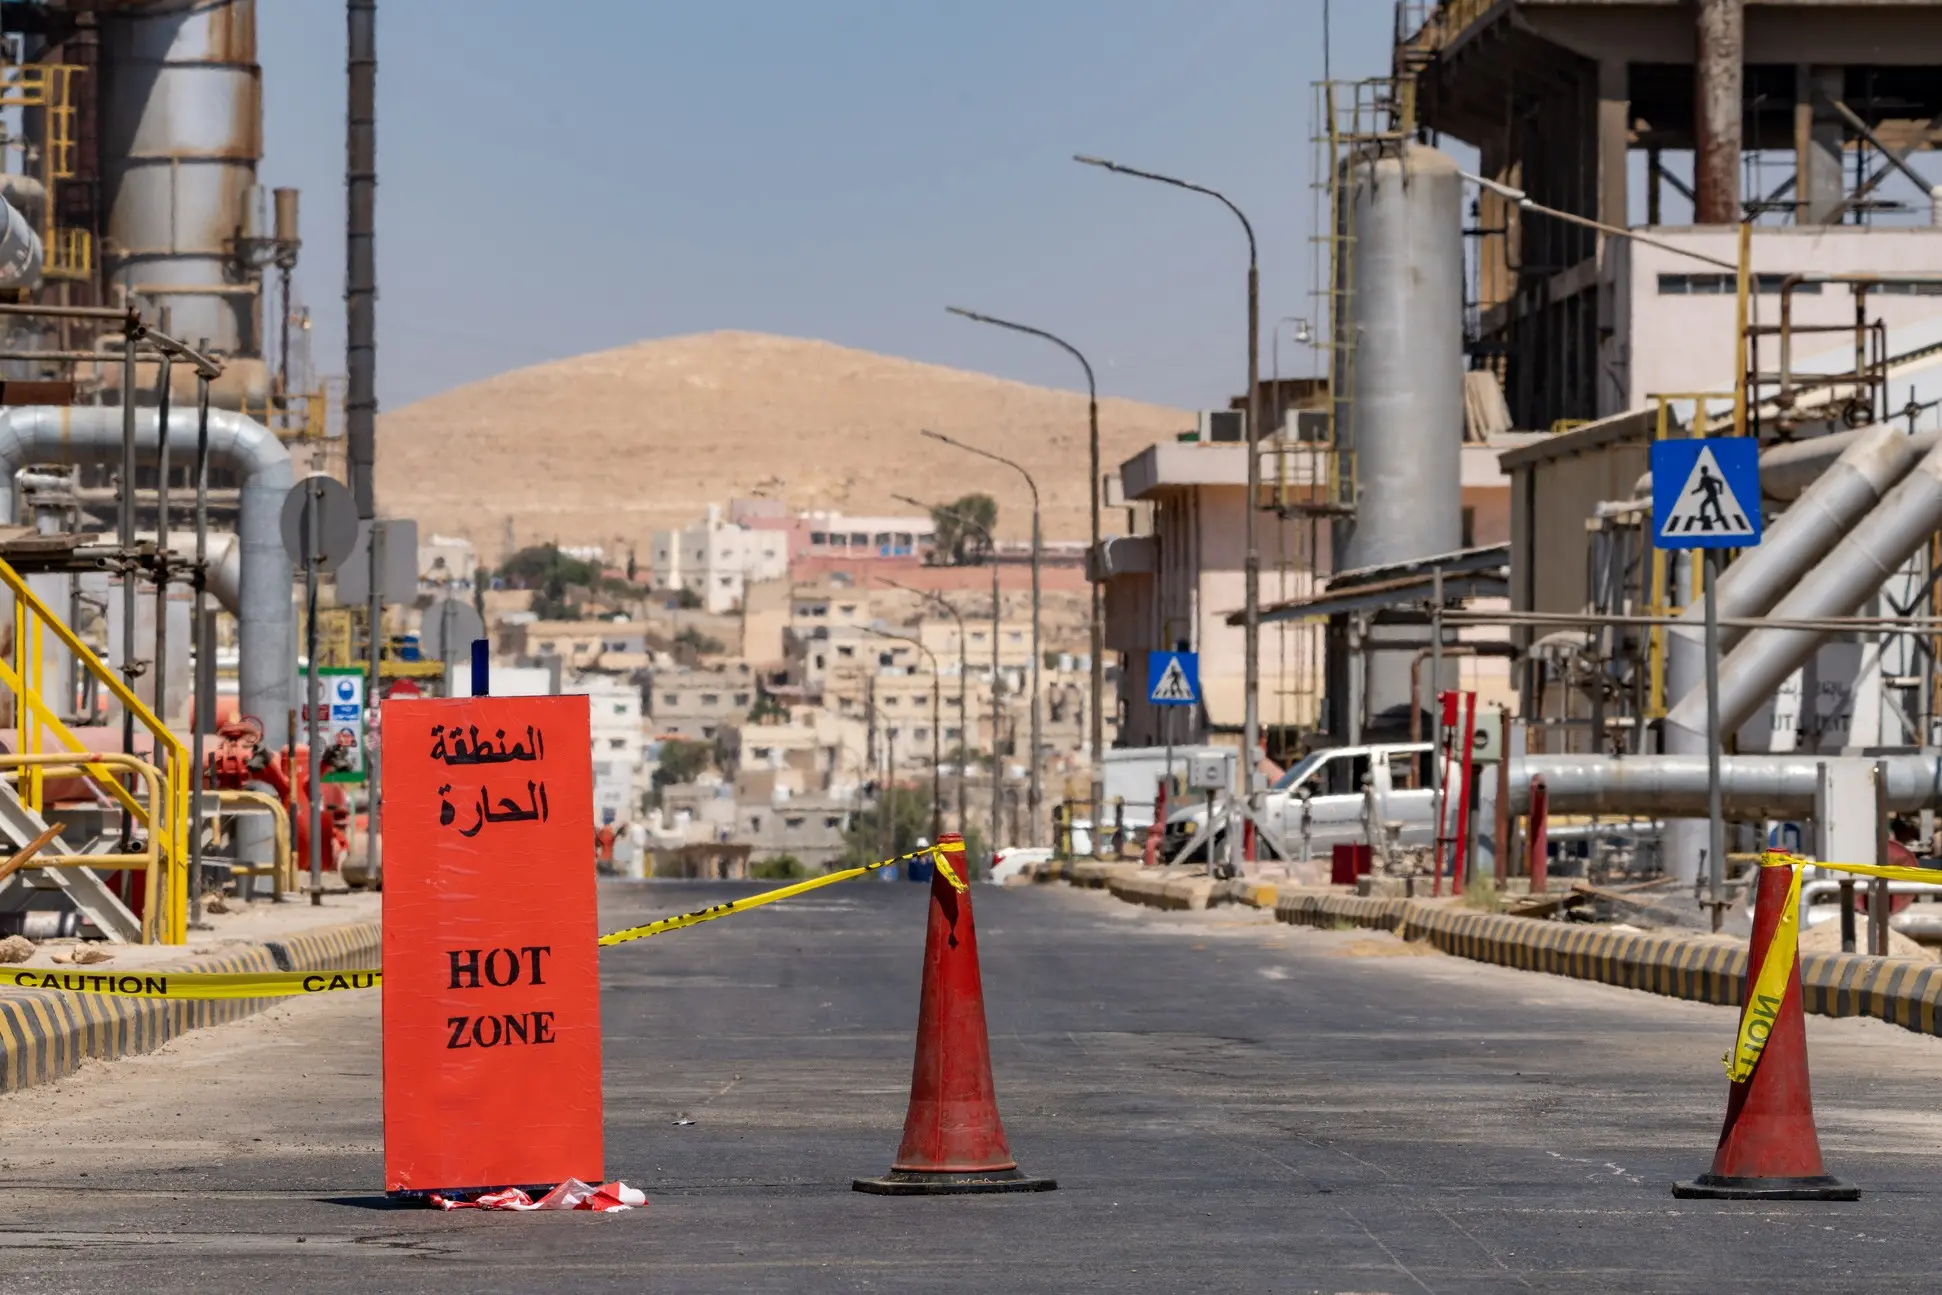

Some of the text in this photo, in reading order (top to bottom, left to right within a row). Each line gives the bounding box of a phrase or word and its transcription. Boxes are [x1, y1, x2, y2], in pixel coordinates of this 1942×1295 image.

[430, 725, 543, 765] المنطقة
[438, 780, 548, 837] الحارة
[15, 972, 167, 995] CAUTION
[447, 946, 550, 989] HOT
[447, 1012, 555, 1049] ZONE
